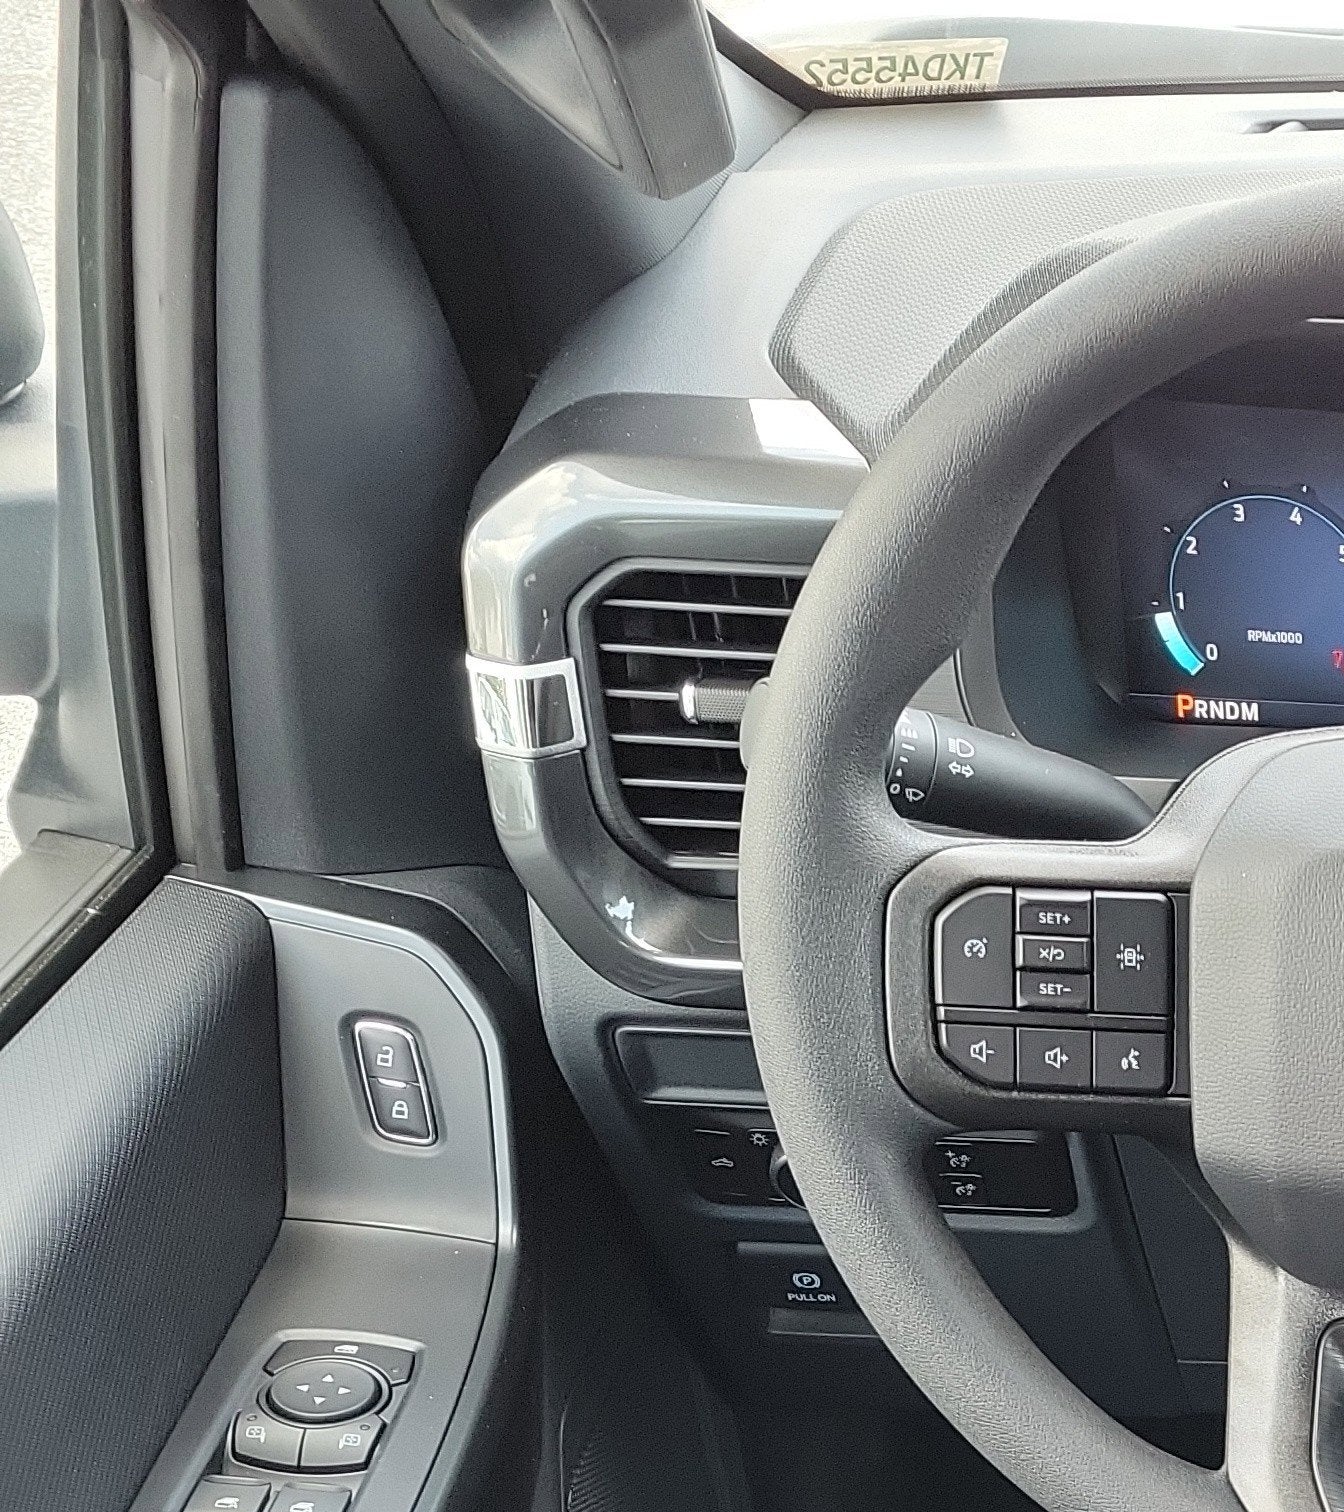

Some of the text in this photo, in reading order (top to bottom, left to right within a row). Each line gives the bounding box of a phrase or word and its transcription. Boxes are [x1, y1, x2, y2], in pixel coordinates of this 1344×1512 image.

[1233, 503, 1245, 522] 3
[1289, 506, 1303, 525] 4
[1186, 536, 1198, 555] 2
[1176, 591, 1184, 611] 1
[1247, 630, 1303, 644] RPMx1000
[1206, 643, 1218, 660] 0
[1038, 911, 1071, 926] SET+
[787, 1292, 837, 1302] PULL ON
